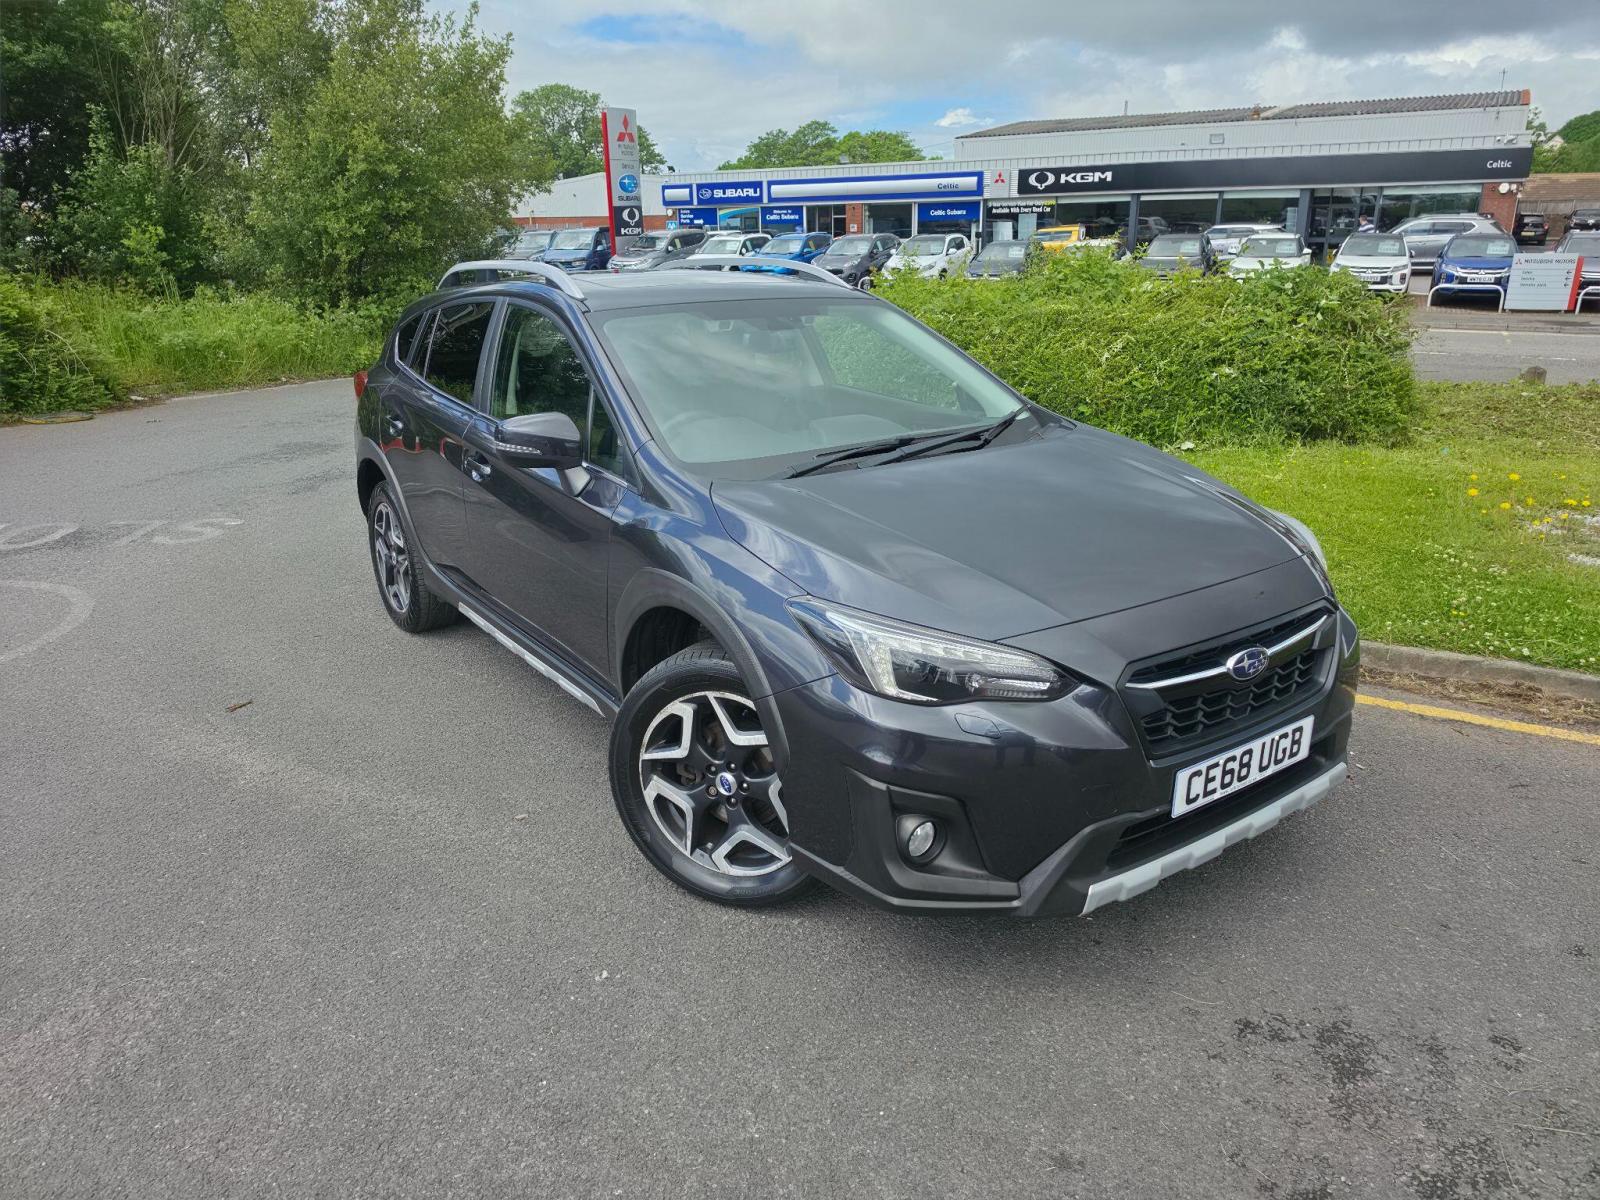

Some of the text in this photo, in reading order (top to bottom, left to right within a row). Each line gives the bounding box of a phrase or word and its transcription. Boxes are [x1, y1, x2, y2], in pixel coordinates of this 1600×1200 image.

[1486, 160, 1512, 169] Celtic
[1060, 171, 1113, 184] KGM
[937, 182, 959, 190] Celtic
[713, 188, 760, 198] SUBARU
[1185, 748, 1254, 806] CE68
[1258, 725, 1304, 773] UGB
